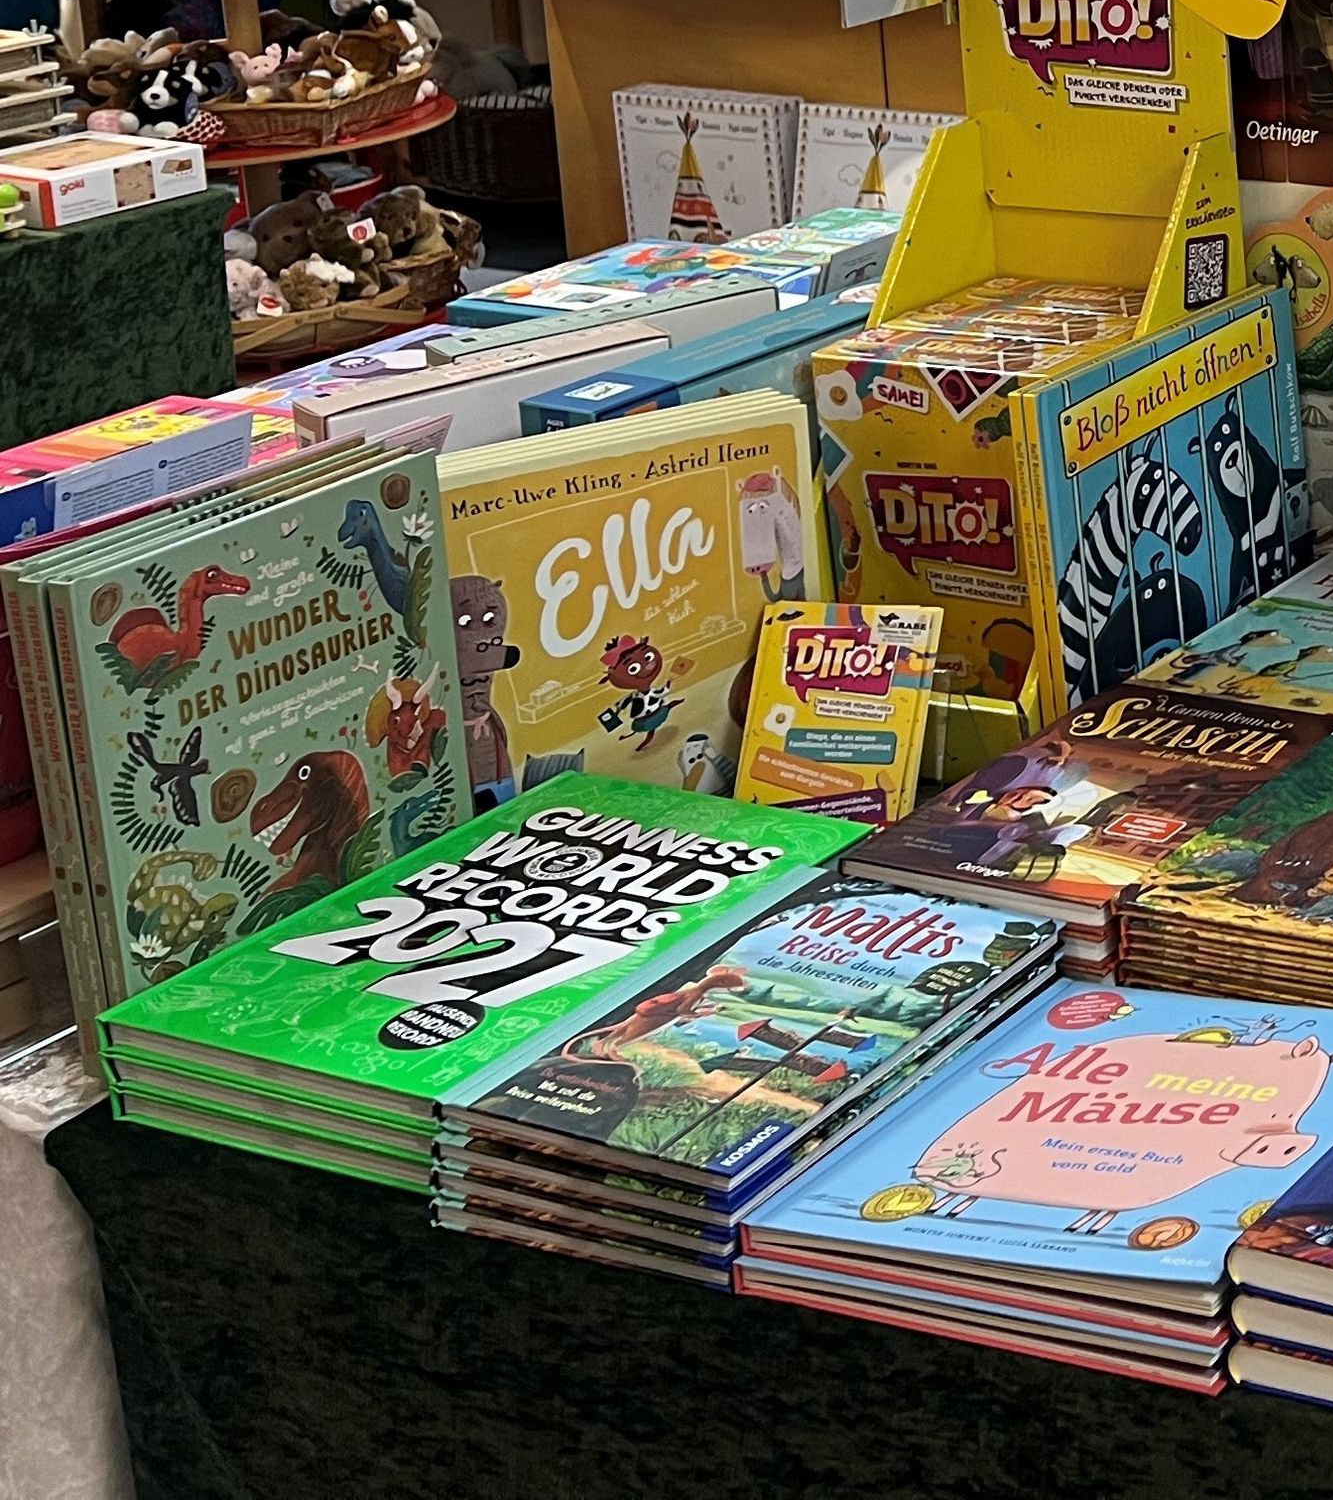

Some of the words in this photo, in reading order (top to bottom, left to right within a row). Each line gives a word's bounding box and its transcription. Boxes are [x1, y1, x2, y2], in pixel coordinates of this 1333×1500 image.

[1067, 76, 1084, 88] DAS
[1086, 78, 1121, 92] GLEICHE
[1159, 85, 1183, 97] ODER
[1074, 90, 1107, 103] PUNKTE
[1246, 120, 1319, 147] Oetinger
[451, 483, 557, 521] Marc-Uwe
[565, 472, 623, 498] Kling
[644, 447, 710, 481] Astrid
[719, 439, 771, 467] Henn
[534, 498, 715, 659] Ella
[178, 684, 228, 728] DER
[523, 805, 785, 873] GUINNESS
[464, 831, 731, 905] WORLD
[955, 861, 1010, 879] Oetinger
[397, 862, 682, 942] RECORDS
[800, 904, 965, 961] Mattis
[756, 953, 780, 972] die
[783, 956, 880, 993] Jahreszeiten
[778, 934, 859, 968] Reise
[849, 958, 897, 979] durch
[992, 1041, 1129, 1085] Alle
[1144, 1072, 1281, 1103] meine
[997, 1090, 1241, 1126] Mäuse
[722, 1124, 779, 1168] KOSMOS
[1040, 1137, 1084, 1153] Mein
[1088, 1145, 1138, 1161] erstes
[1141, 1150, 1185, 1166] Buch
[1051, 1161, 1089, 1171] vom
[1093, 1160, 1138, 1174] Geld
